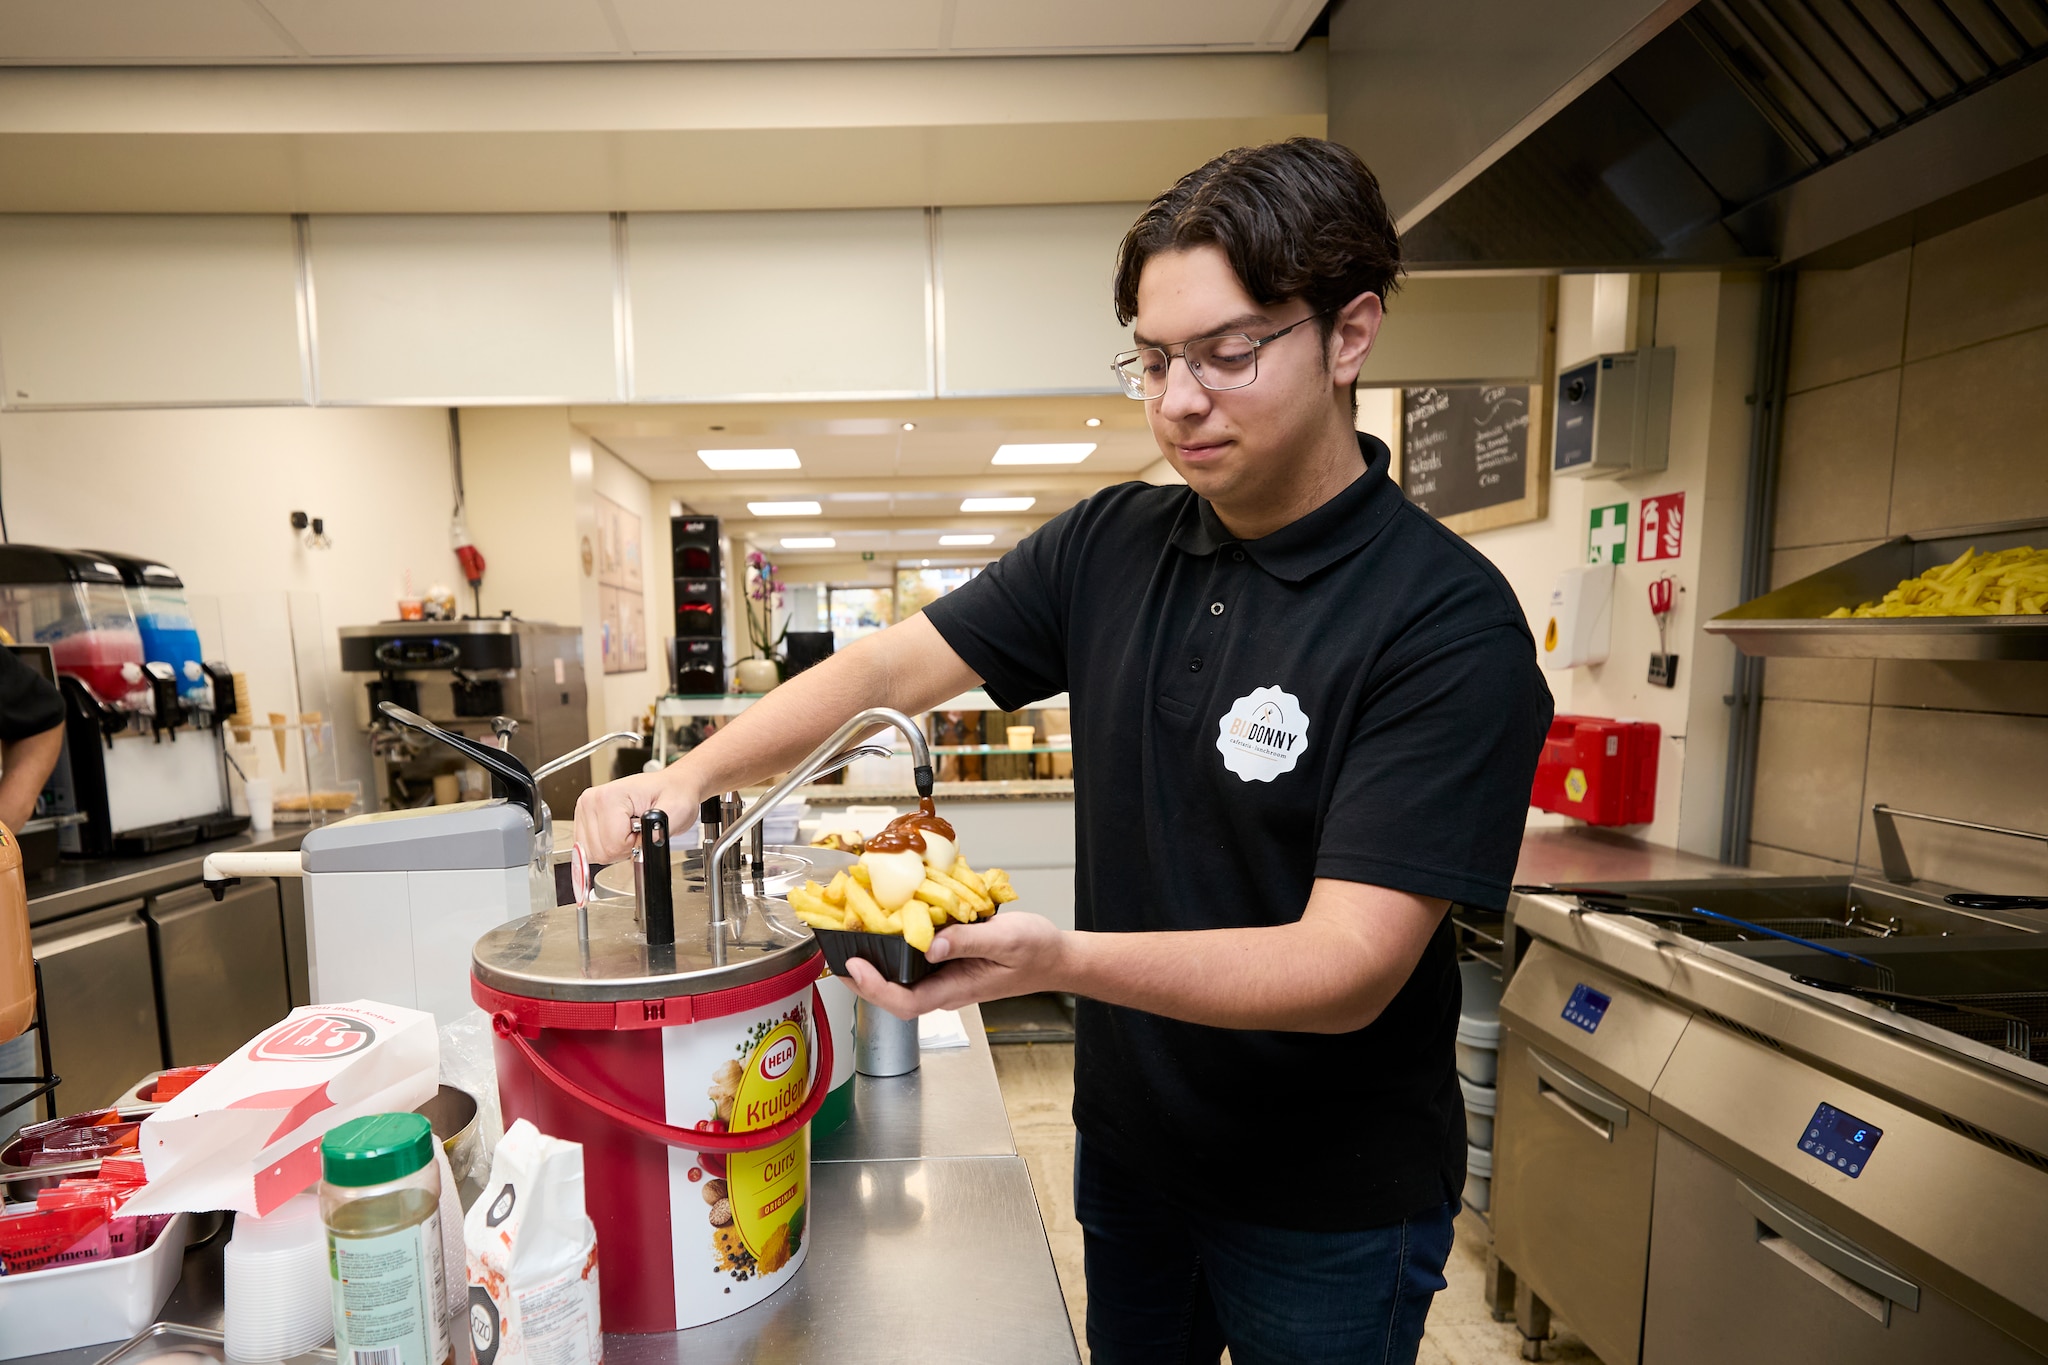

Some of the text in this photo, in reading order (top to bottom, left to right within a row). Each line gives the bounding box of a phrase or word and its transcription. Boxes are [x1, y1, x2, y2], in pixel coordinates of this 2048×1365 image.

[1254, 746, 1287, 759] lunchroom
[333, 1006, 361, 1014] your
[362, 1011, 396, 1025] Enjoy
[768, 1046, 793, 1069] HELA
[746, 1077, 804, 1126] Kruiden
[1853, 1129, 1867, 1143] 6
[763, 1150, 796, 1183] Curry
[764, 1187, 796, 1215] ORIGINAL
[1, 1244, 52, 1260] Sauce
